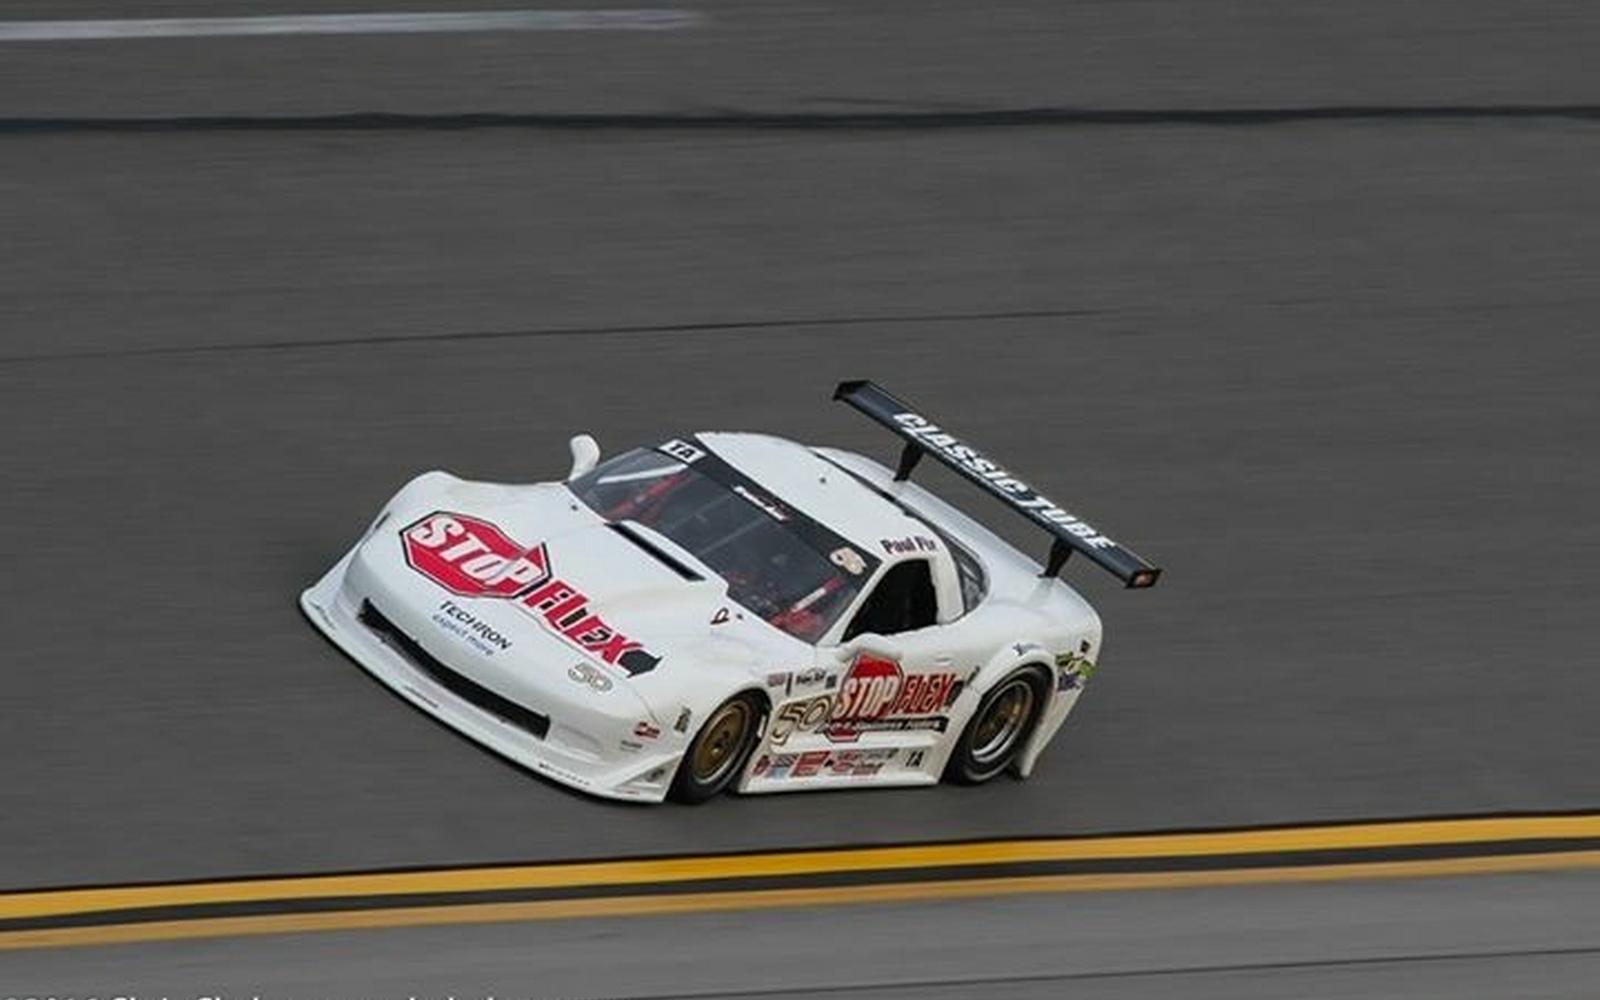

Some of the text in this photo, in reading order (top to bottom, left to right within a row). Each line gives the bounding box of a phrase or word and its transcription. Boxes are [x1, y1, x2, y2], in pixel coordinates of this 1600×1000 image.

[669, 443, 695, 459] TA
[893, 412, 1117, 549] CLASSIC TUBE
[410, 516, 544, 587] STOP
[880, 536, 917, 554] Paul
[440, 601, 512, 650] TECHRON
[522, 579, 645, 666] FLEX
[568, 662, 613, 692] 50
[831, 671, 956, 719] STOP FLEX
[769, 694, 836, 747] 50
